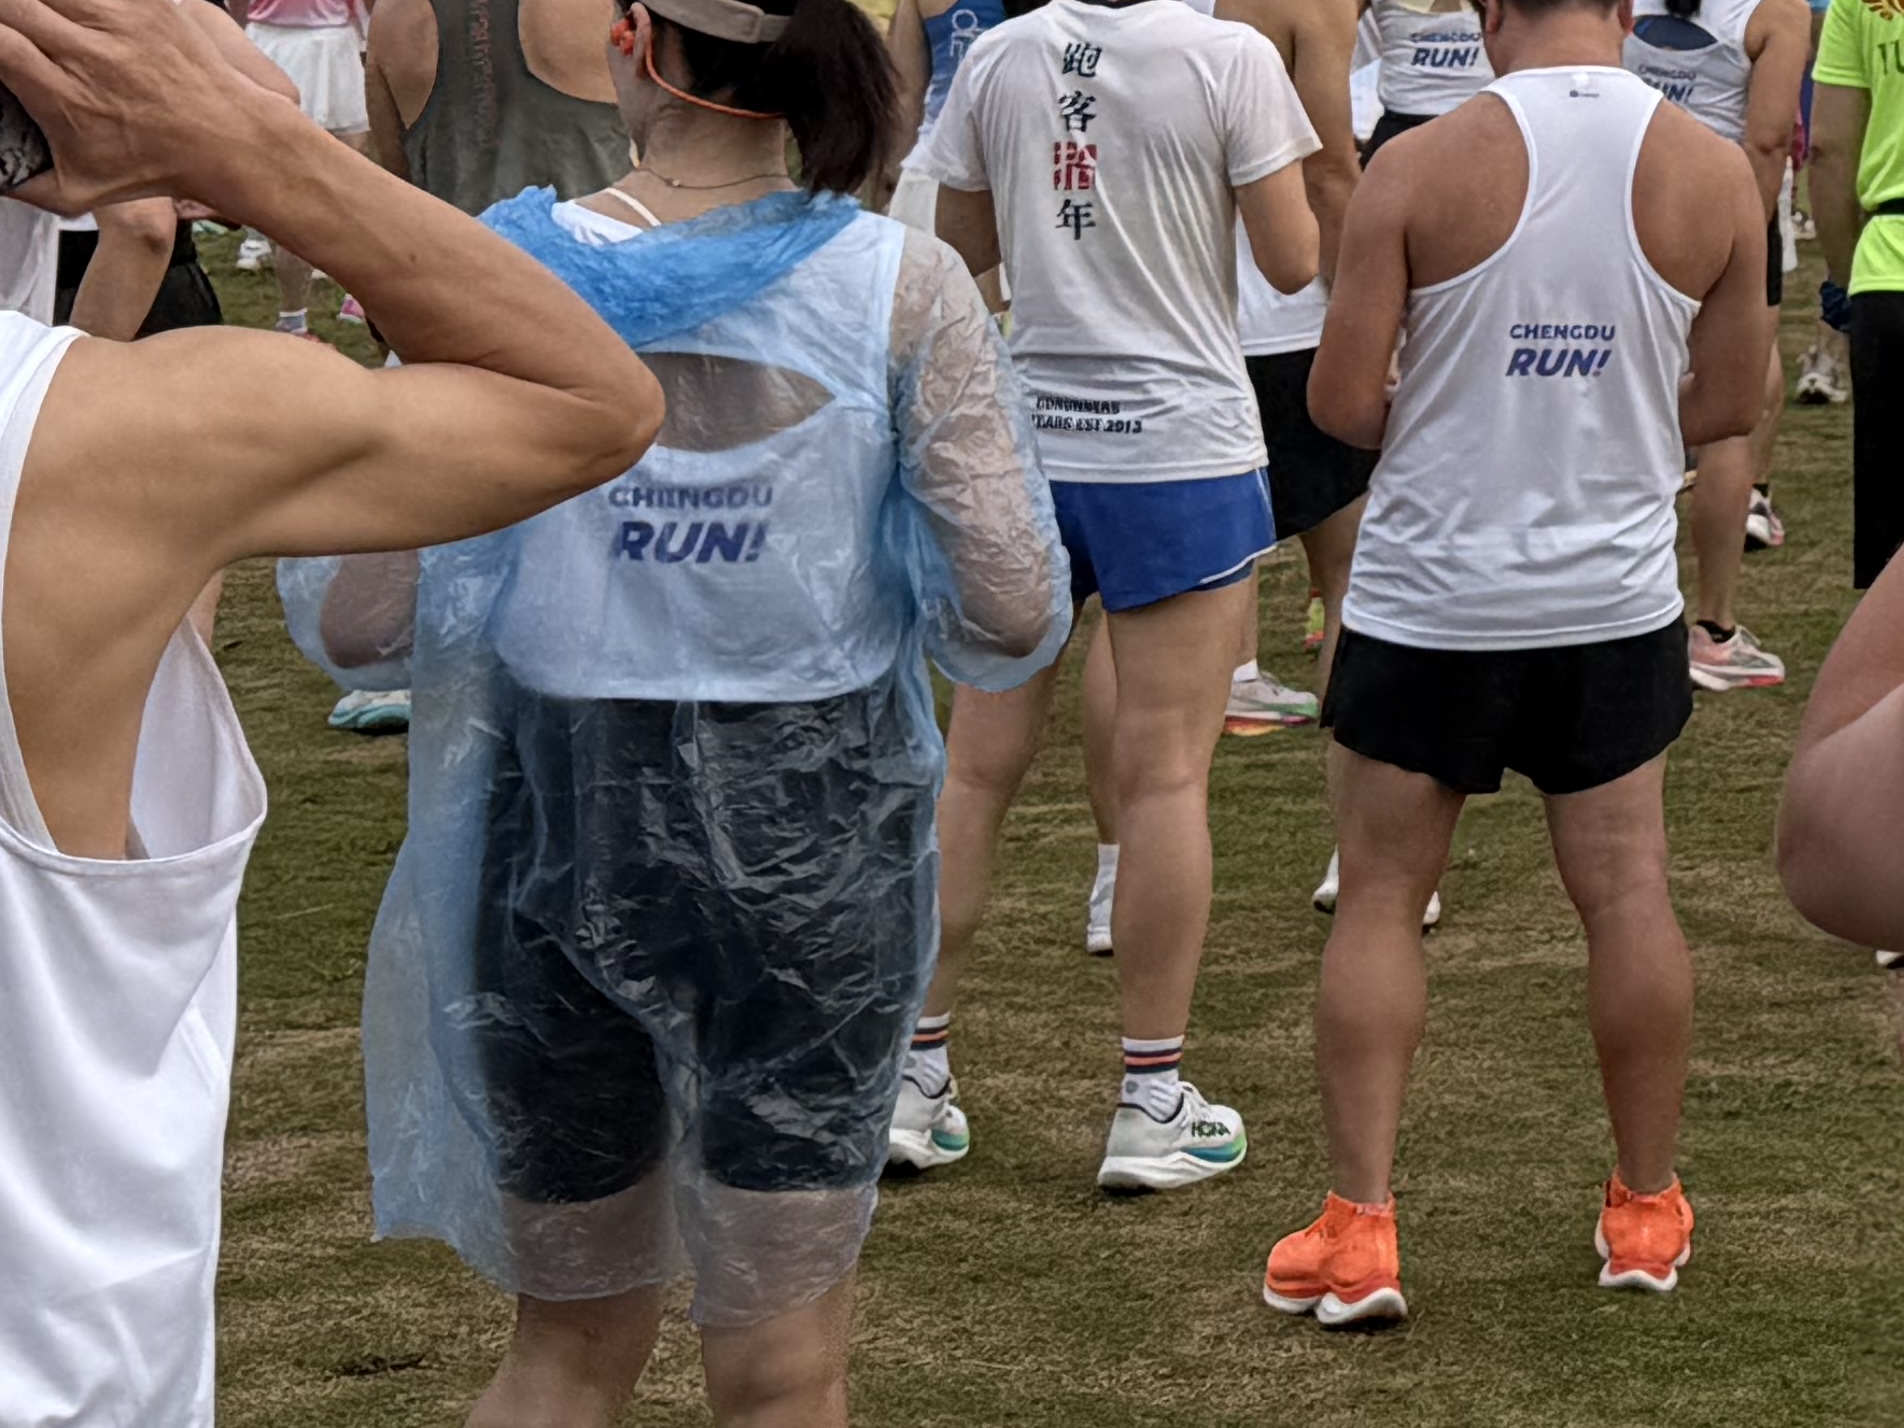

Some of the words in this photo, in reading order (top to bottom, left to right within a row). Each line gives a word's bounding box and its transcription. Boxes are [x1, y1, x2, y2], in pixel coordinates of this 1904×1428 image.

[1411, 47, 1479, 67] RUN!
[1648, 82, 1693, 104] UN!
[1509, 324, 1616, 341] CHENGDU
[1505, 348, 1613, 378] RUN!
[608, 521, 769, 564] RUN!
